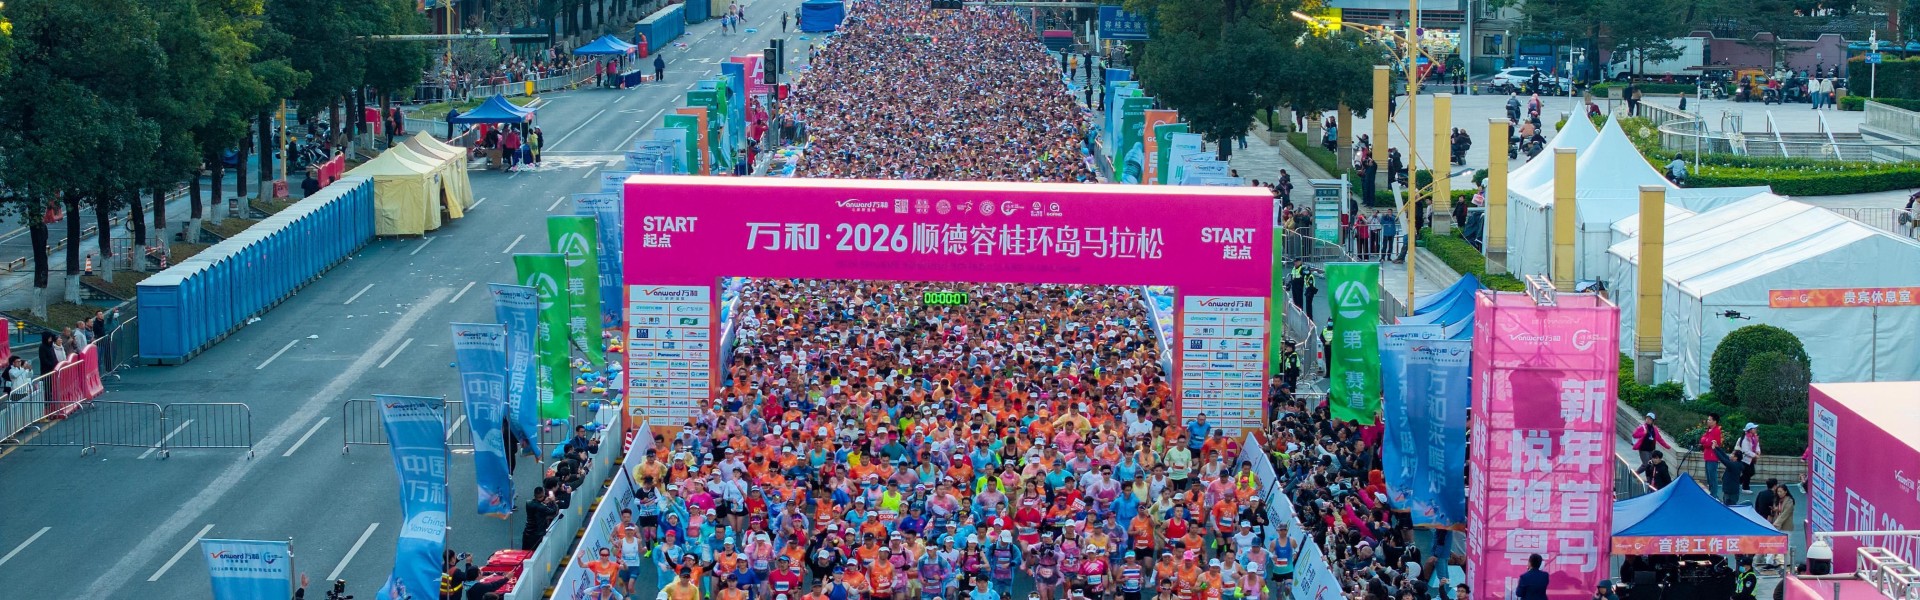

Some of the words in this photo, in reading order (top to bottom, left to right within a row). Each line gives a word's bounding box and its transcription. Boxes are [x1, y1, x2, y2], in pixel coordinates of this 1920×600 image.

[643, 216, 698, 232] START
[643, 233, 671, 248] 起点
[1201, 227, 1256, 244] START
[1223, 245, 1251, 259] 起点
[1844, 290, 1911, 304] 贵宾休息室
[1343, 330, 1365, 409] 第一赛道
[468, 379, 502, 400] 中国
[402, 454, 445, 477] 中国
[1555, 379, 1606, 573] 新年首马
[421, 516, 445, 528] China
[1503, 429, 1553, 600] 悦跑粤
[1659, 538, 1740, 553] 音控工作区
